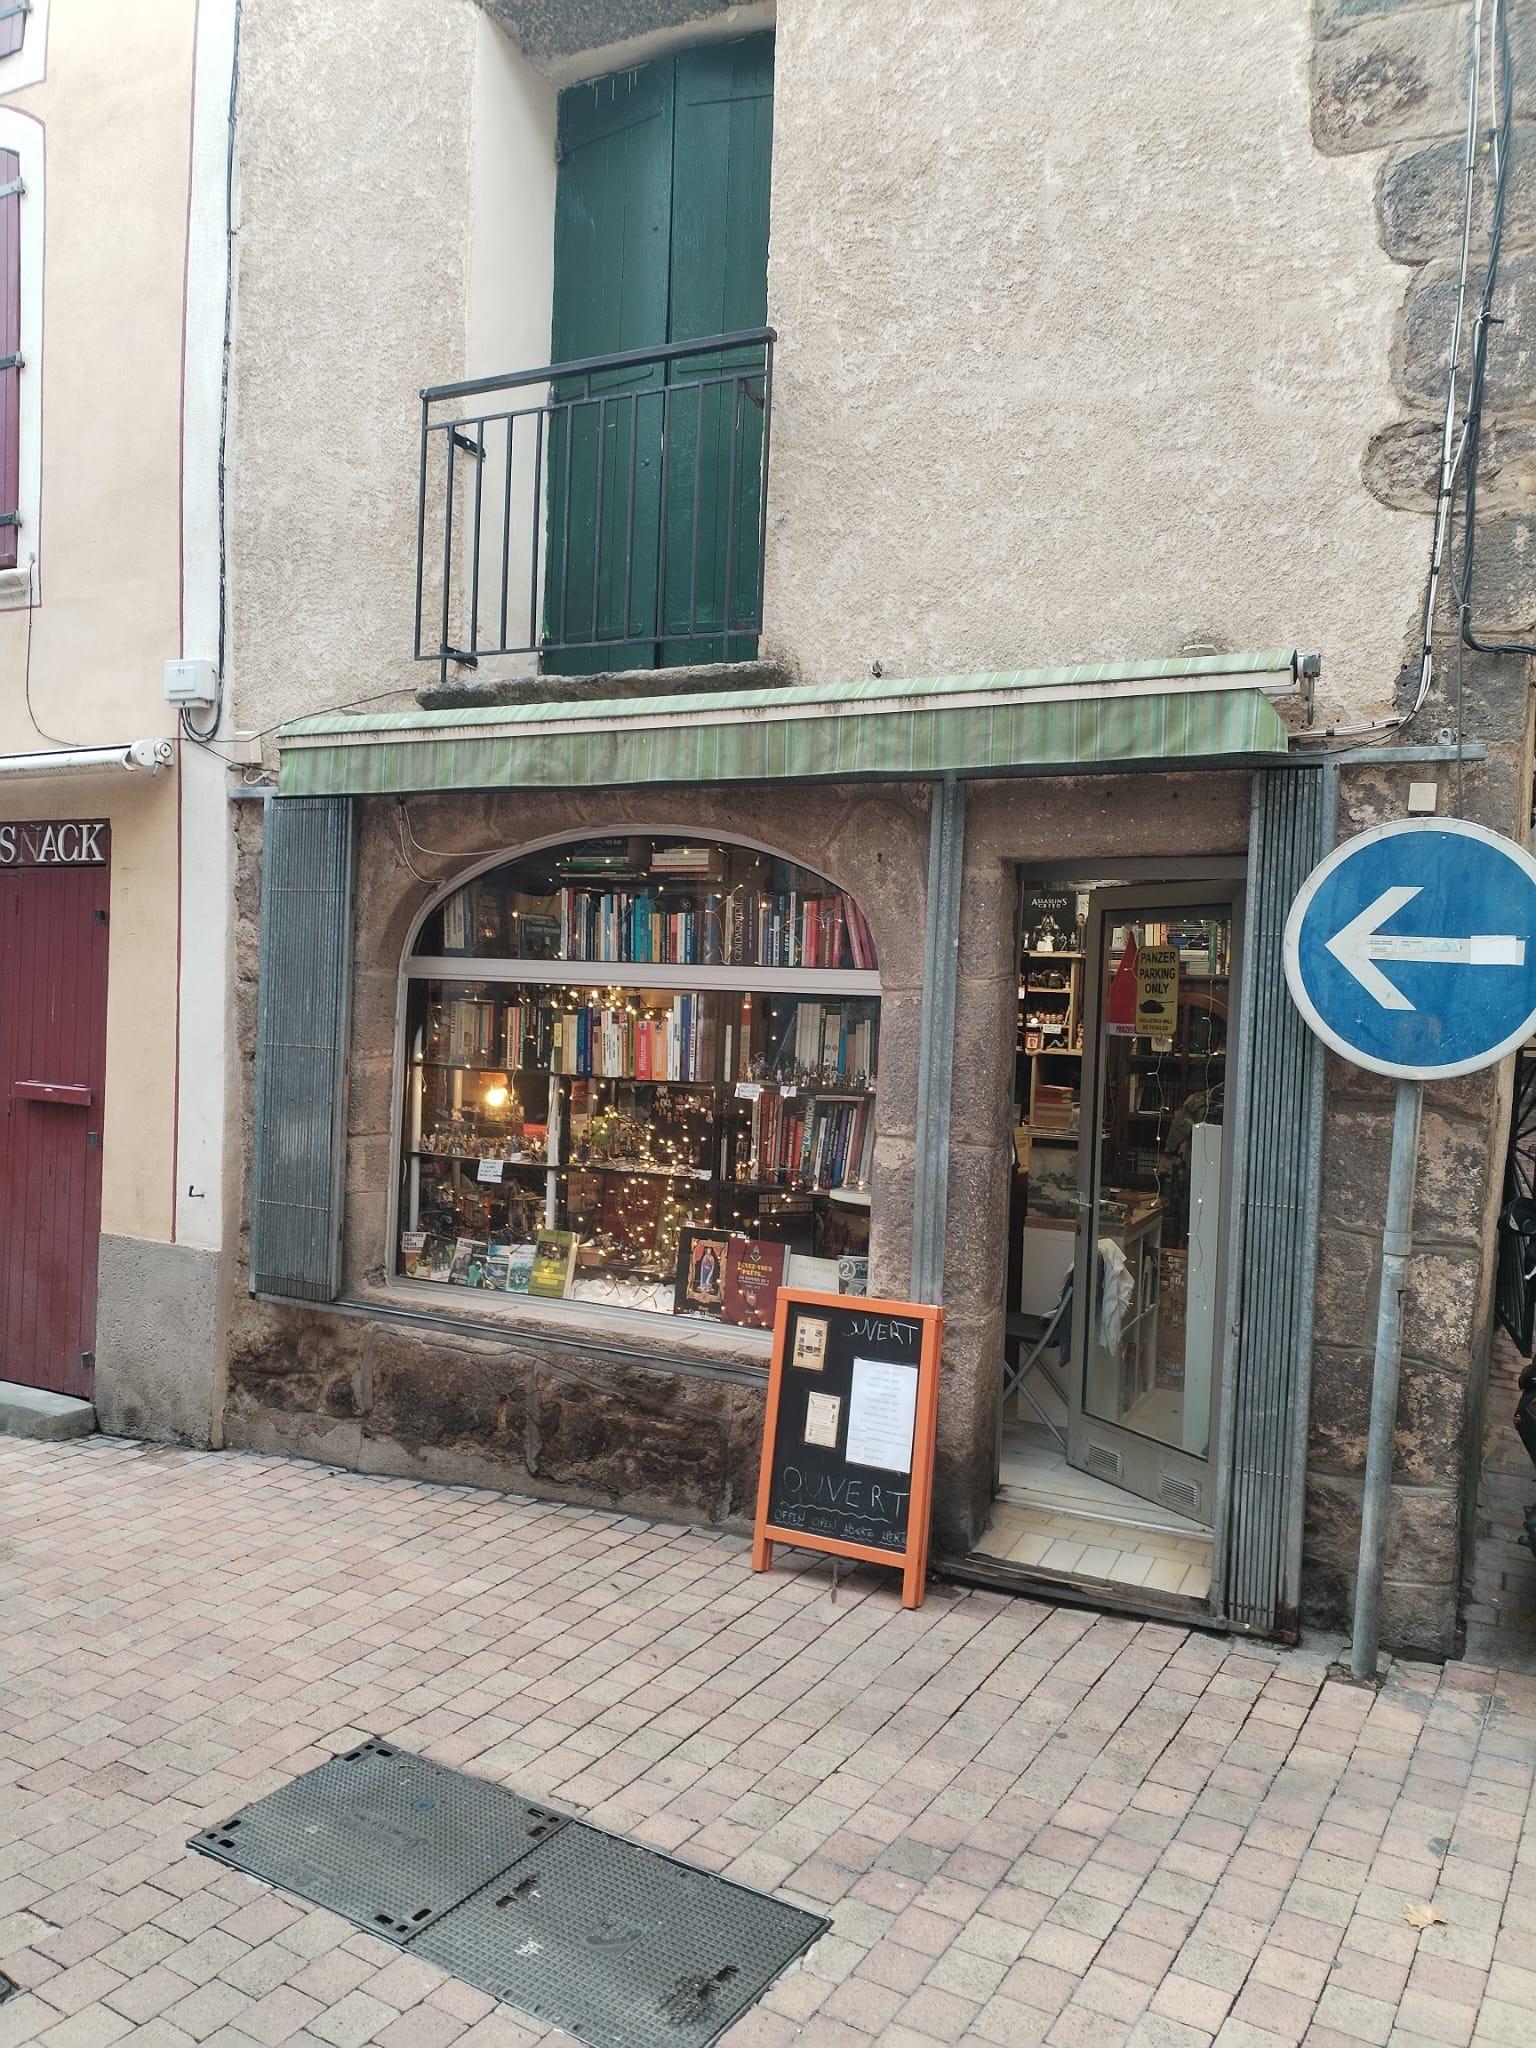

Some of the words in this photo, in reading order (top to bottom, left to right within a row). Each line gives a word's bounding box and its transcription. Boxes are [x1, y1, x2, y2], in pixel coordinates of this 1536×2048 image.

[0, 823, 105, 864] SNACK
[1140, 951, 1176, 964] PANZER
[1139, 967, 1176, 980] PARKING
[1144, 983, 1170, 994] ONLY
[783, 1466, 910, 1518] OUVERT
